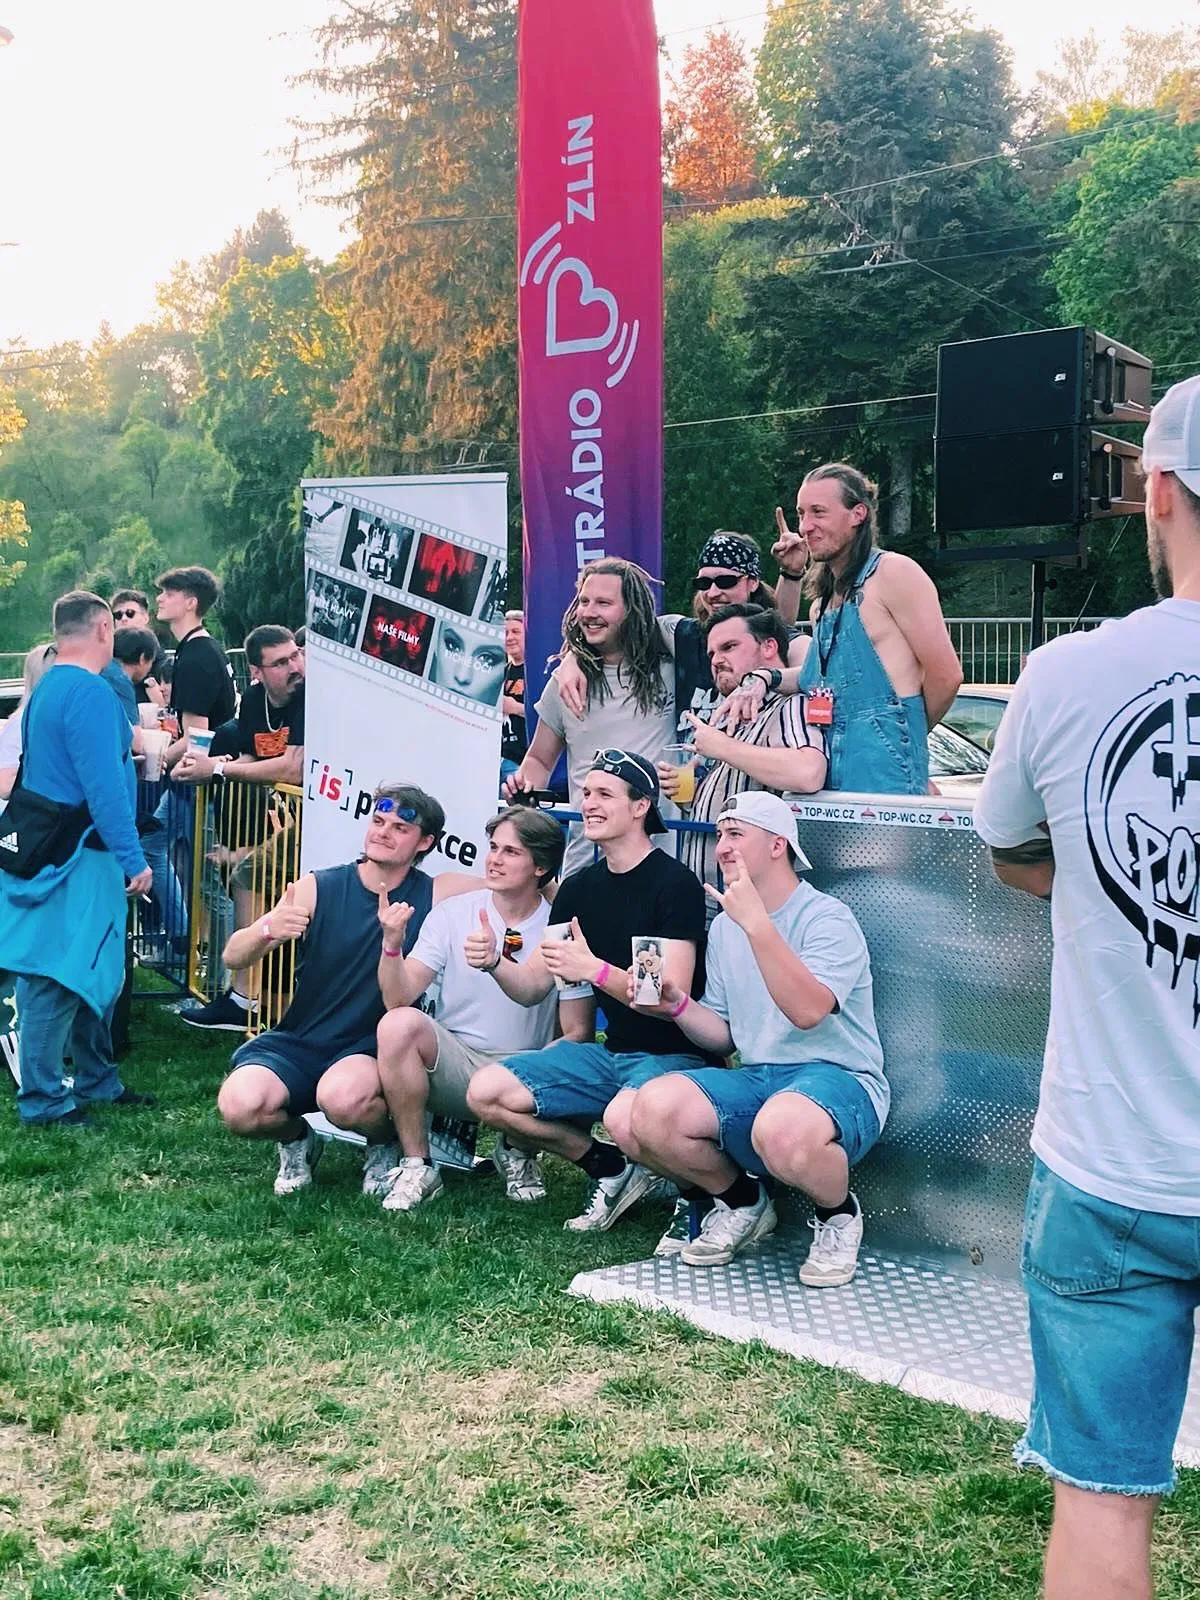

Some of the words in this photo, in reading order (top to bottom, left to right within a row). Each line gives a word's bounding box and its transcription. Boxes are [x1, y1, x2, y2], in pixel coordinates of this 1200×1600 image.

[560, 114, 595, 225] ZLÍN
[565, 388, 605, 580] TRÁDIO
[377, 622, 397, 637] NAŠE
[397, 629, 420, 646] FILMY
[804, 806, 855, 820] TOP-WC.CZ
[878, 811, 933, 825] TOP-WC.CZ
